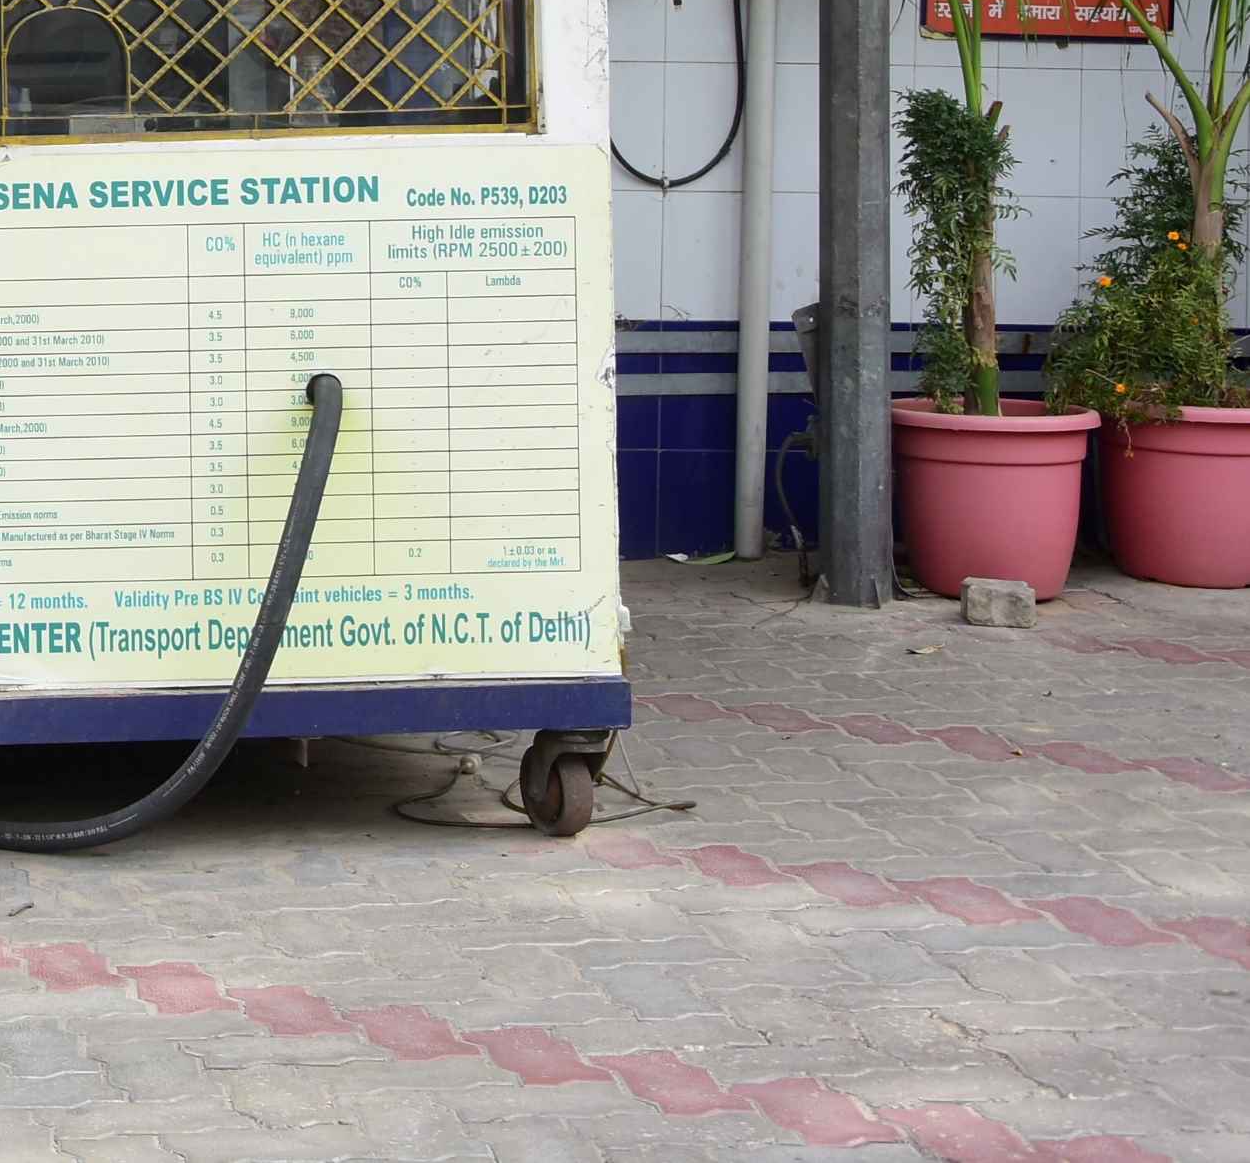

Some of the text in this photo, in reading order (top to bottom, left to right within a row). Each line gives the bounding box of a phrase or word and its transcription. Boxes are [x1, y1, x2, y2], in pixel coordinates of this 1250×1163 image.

[89, 179, 229, 208] SERVICE
[240, 176, 378, 205] STATION
[407, 186, 566, 209] Code No. P539, D203
[263, 232, 280, 247] HC
[301, 232, 345, 246] hexane
[412, 223, 543, 243] High Idle emission
[255, 249, 353, 268] equivalent) ppm
[388, 244, 427, 259] limits
[433, 243, 472, 259] (RPM
[486, 275, 521, 286] Lambda
[9, 593, 25, 610] 12
[31, 592, 88, 609] months.
[115, 590, 169, 610] Validity
[175, 590, 198, 606] Pre
[204, 589, 223, 605] BS
[229, 589, 243, 605] IV
[324, 585, 382, 602] vehicles
[404, 584, 412, 601] 3
[417, 583, 474, 600] months.
[89, 621, 201, 661] (Transport
[207, 617, 334, 657] Depment
[340, 615, 395, 646] Govt.
[404, 614, 425, 645] of
[432, 613, 492, 644] N.C.T.
[501, 612, 523, 643] of
[528, 611, 591, 650] Delhi)
